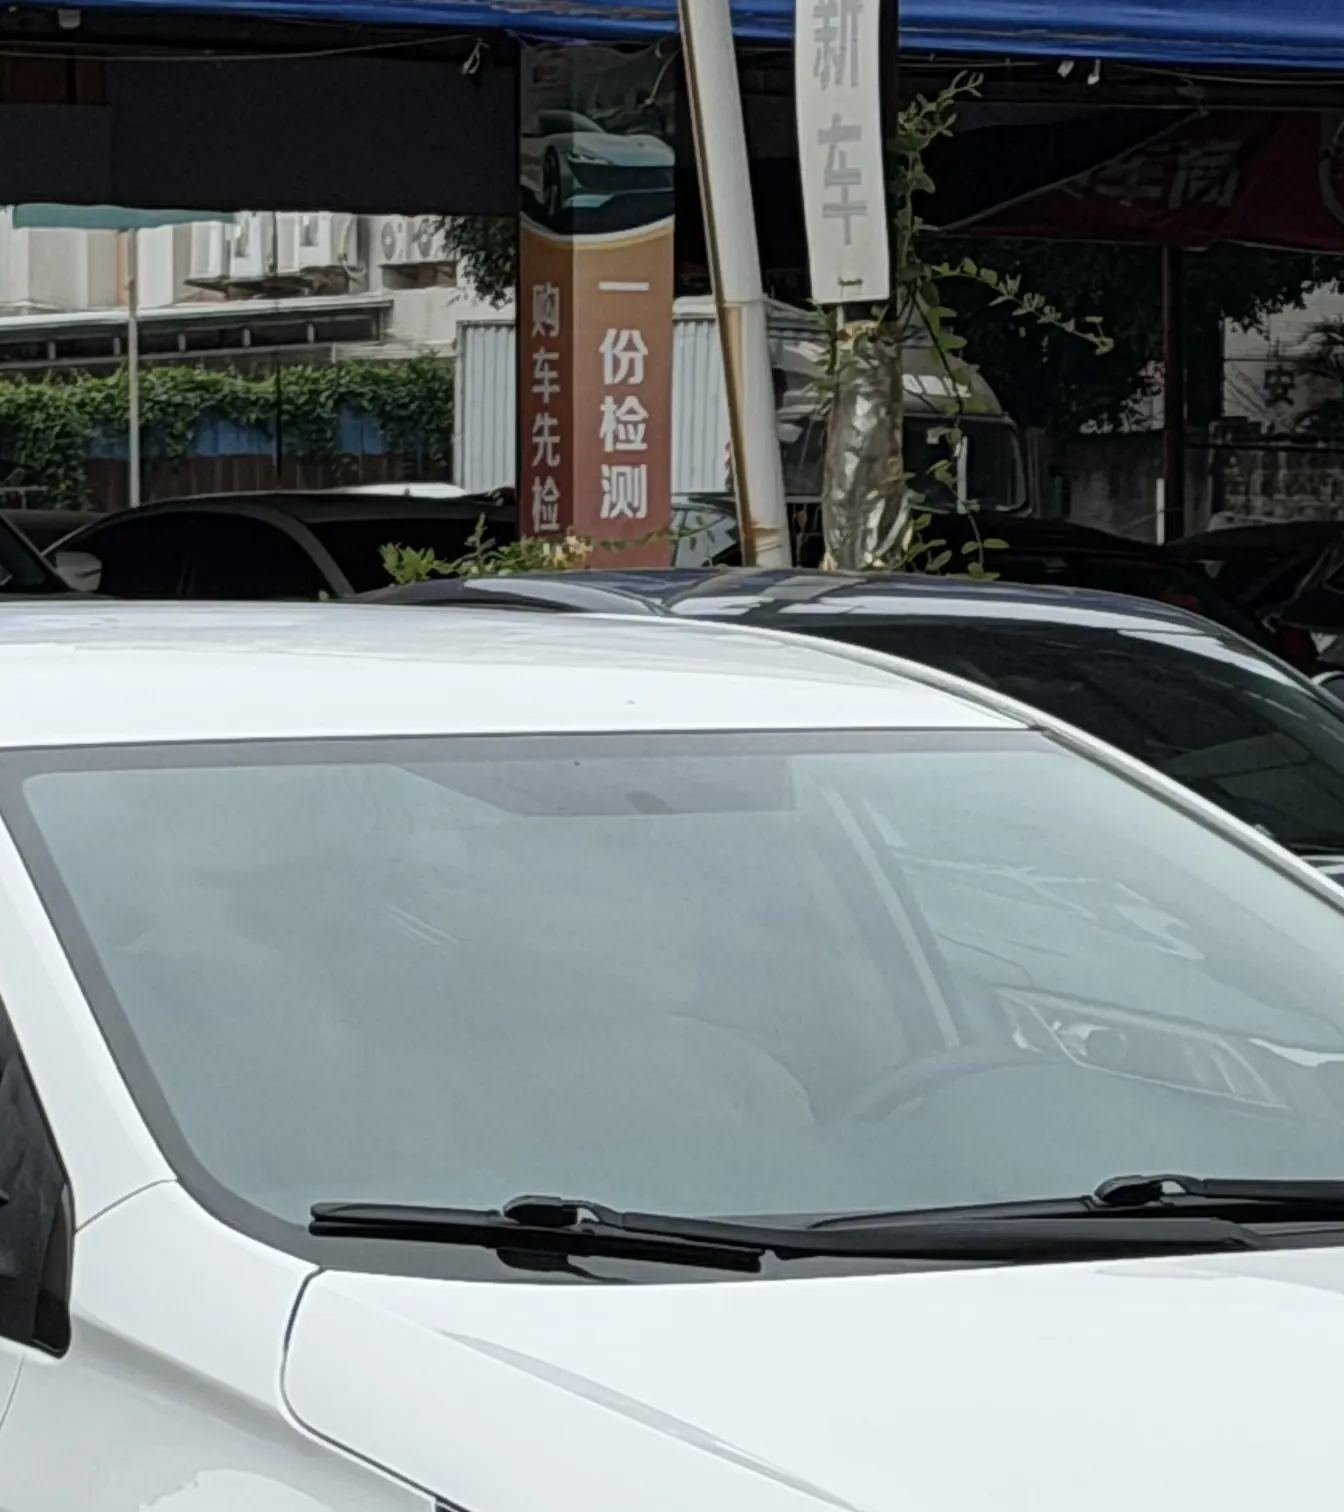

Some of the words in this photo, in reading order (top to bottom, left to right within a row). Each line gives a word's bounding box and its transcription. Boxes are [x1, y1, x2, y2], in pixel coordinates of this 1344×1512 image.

[813, 0, 868, 246] 新车
[531, 281, 562, 557] 购车先检
[598, 280, 649, 520] 一份检测
